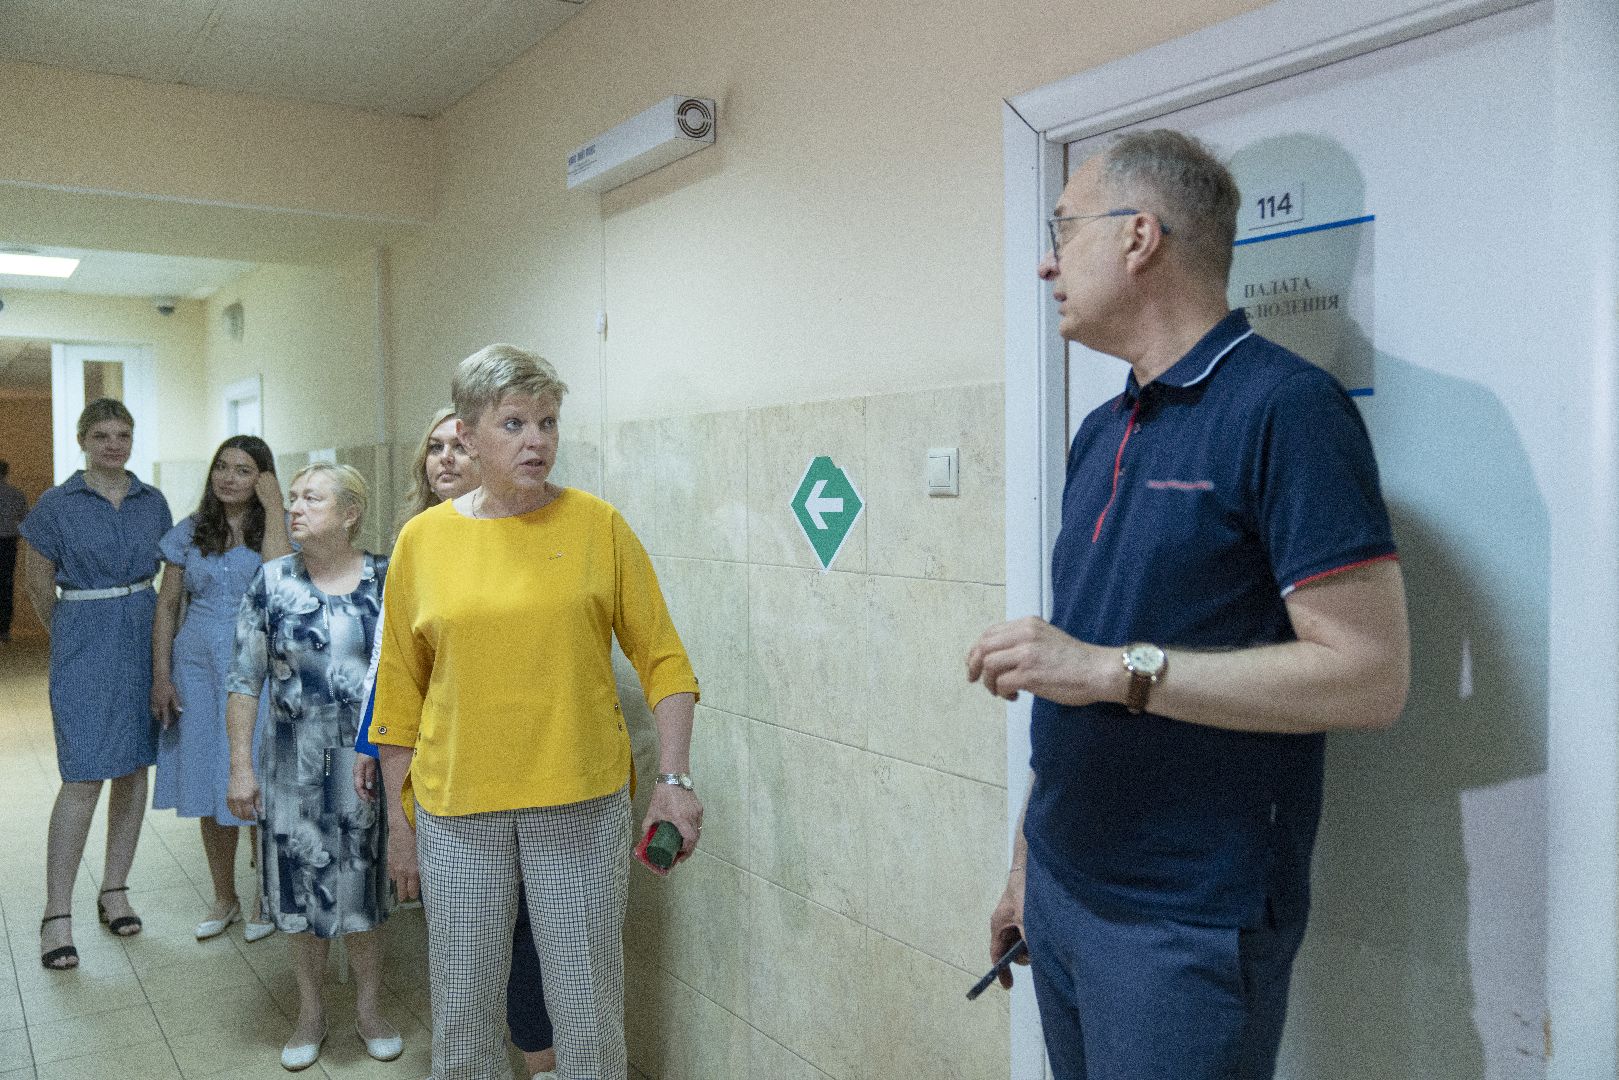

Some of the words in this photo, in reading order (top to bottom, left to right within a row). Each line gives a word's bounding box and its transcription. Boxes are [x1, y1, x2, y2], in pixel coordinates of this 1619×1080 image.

[1257, 192, 1293, 220] 114
[1244, 277, 1312, 299] ПАЛАТА
[1243, 294, 1340, 319] БЛЮДЕНИЯ
